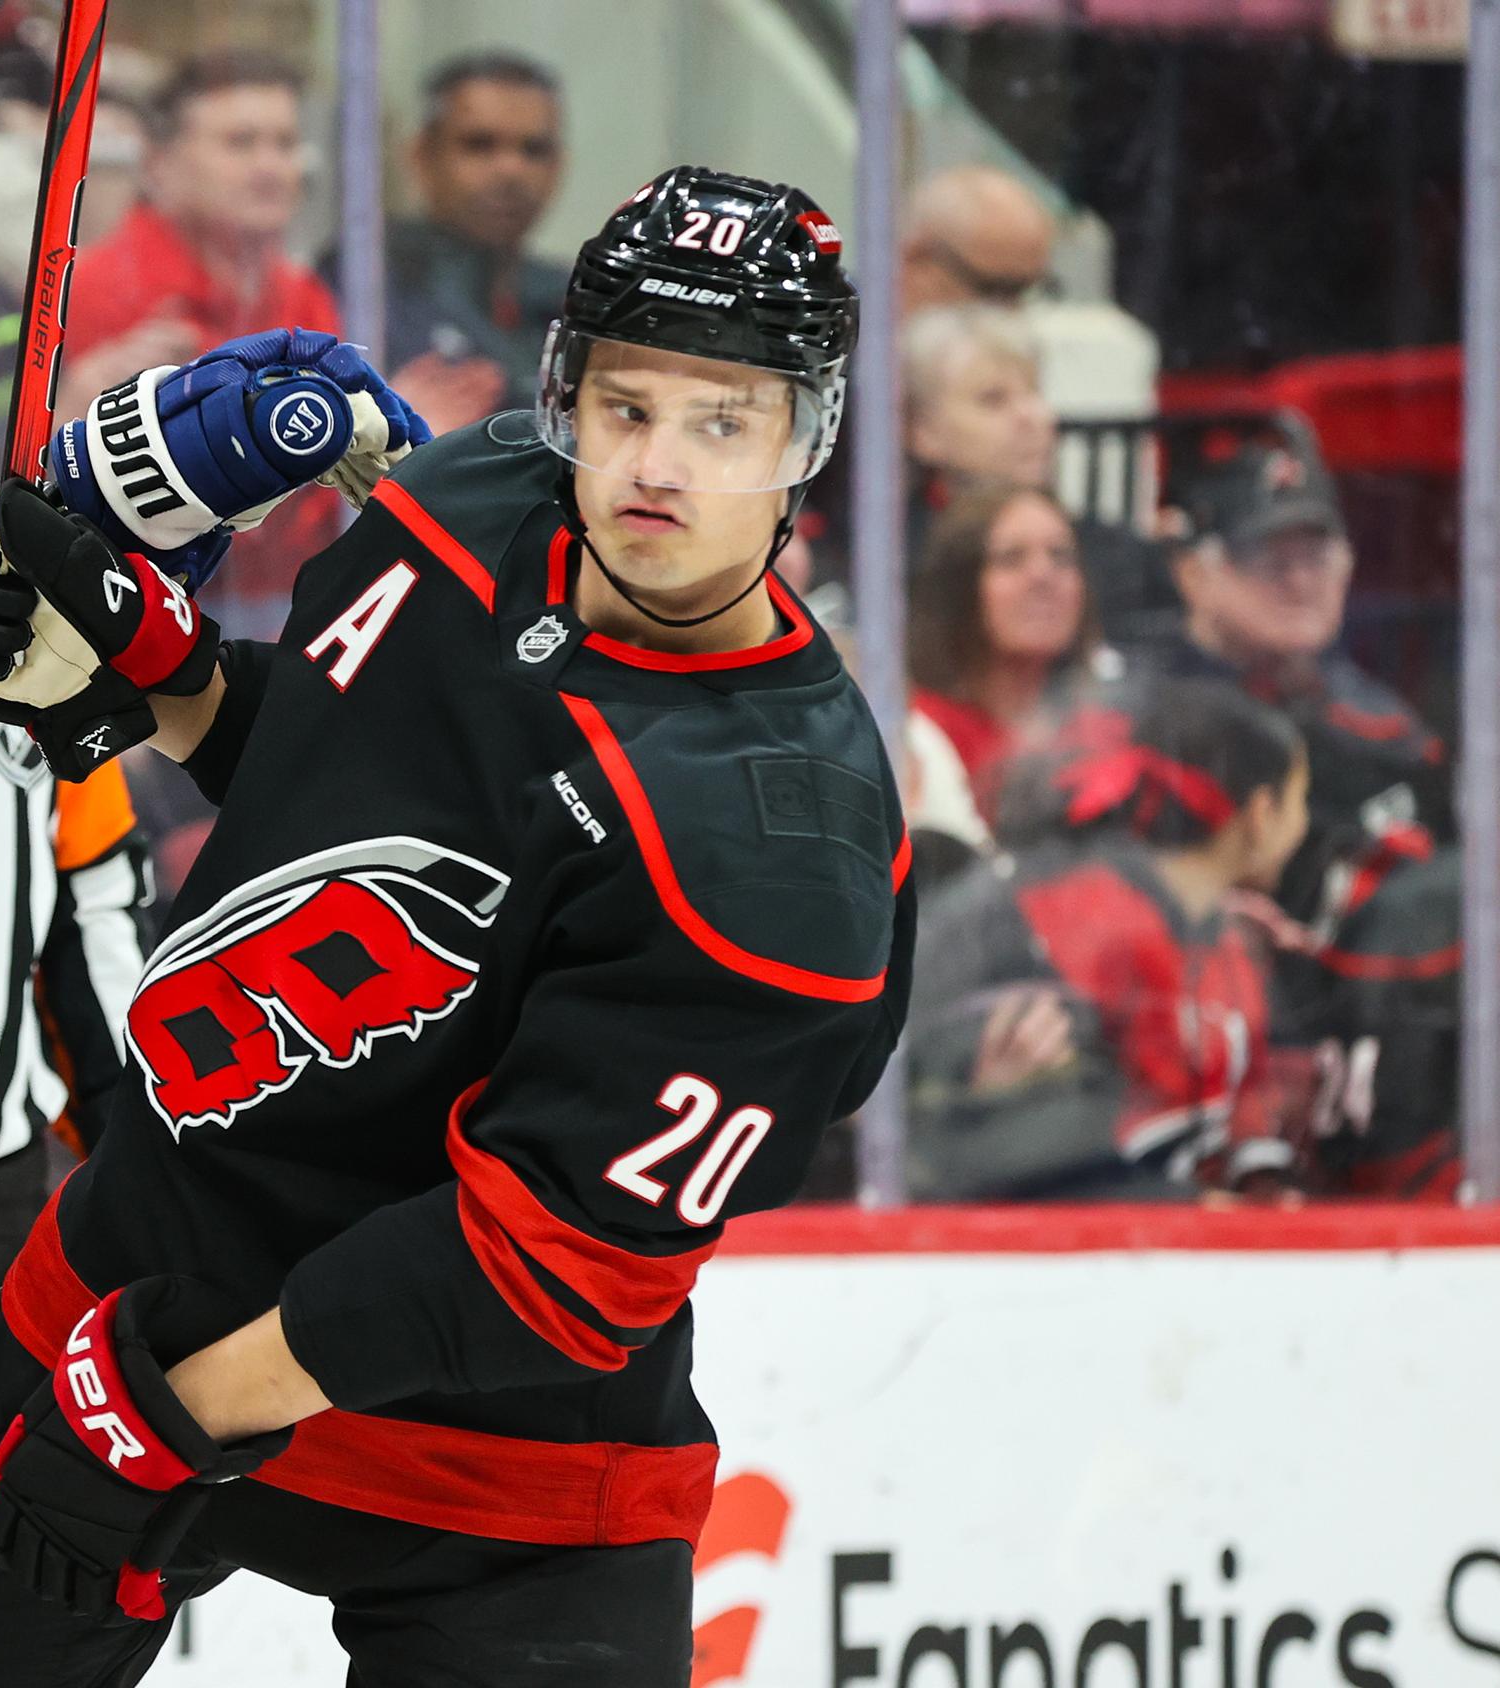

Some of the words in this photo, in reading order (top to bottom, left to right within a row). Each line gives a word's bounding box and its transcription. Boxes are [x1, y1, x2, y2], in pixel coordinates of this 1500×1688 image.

[673, 211, 748, 257] 20
[32, 266, 56, 370] BAUER
[639, 278, 737, 309] BAUER
[303, 559, 420, 694] A
[87, 735, 111, 759] X
[602, 1072, 777, 1228] 20
